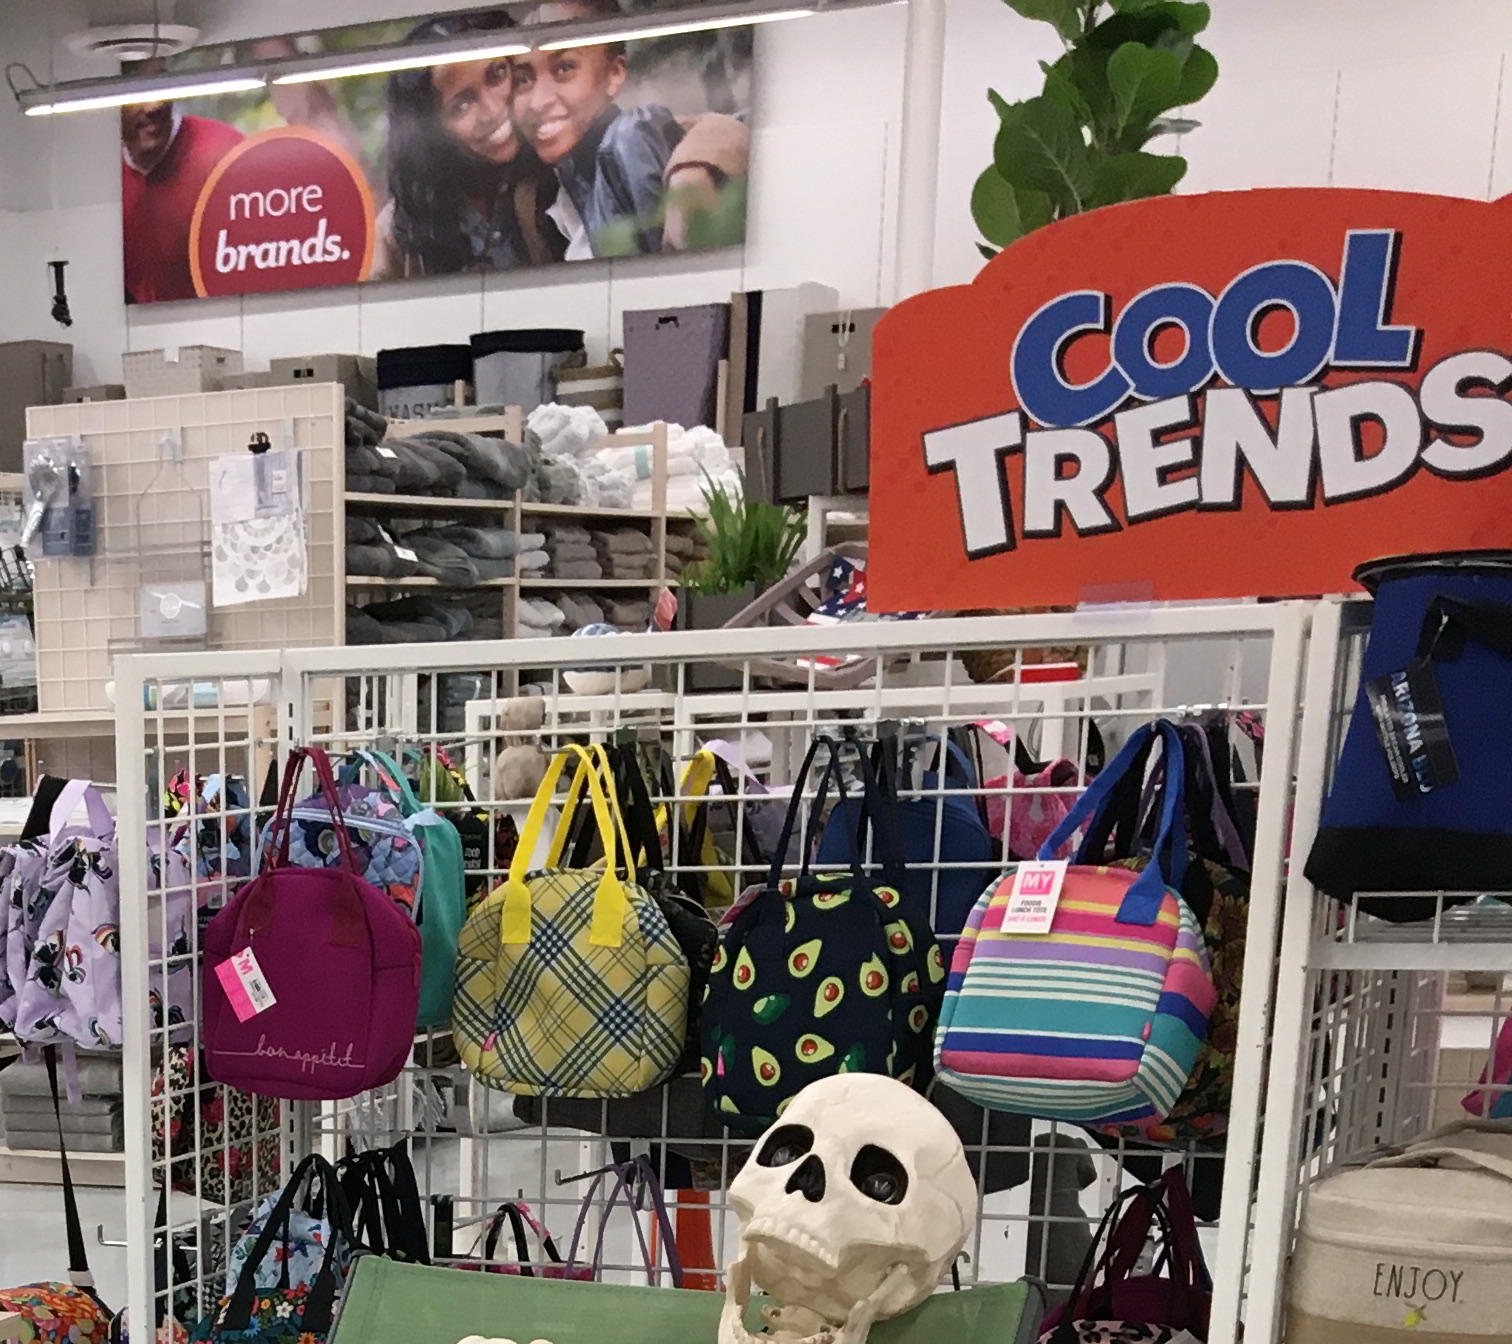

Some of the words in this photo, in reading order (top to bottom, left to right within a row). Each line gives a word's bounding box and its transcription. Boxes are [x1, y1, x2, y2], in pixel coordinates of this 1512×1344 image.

[229, 184, 323, 221] more
[215, 217, 351, 273] brands.
[1010, 228, 1422, 428] COOL
[922, 350, 1512, 560] TRENDS
[1390, 671, 1424, 755] ARIZONA
[1022, 872, 1053, 889] MY
[1373, 1262, 1464, 1303] ENJOY
